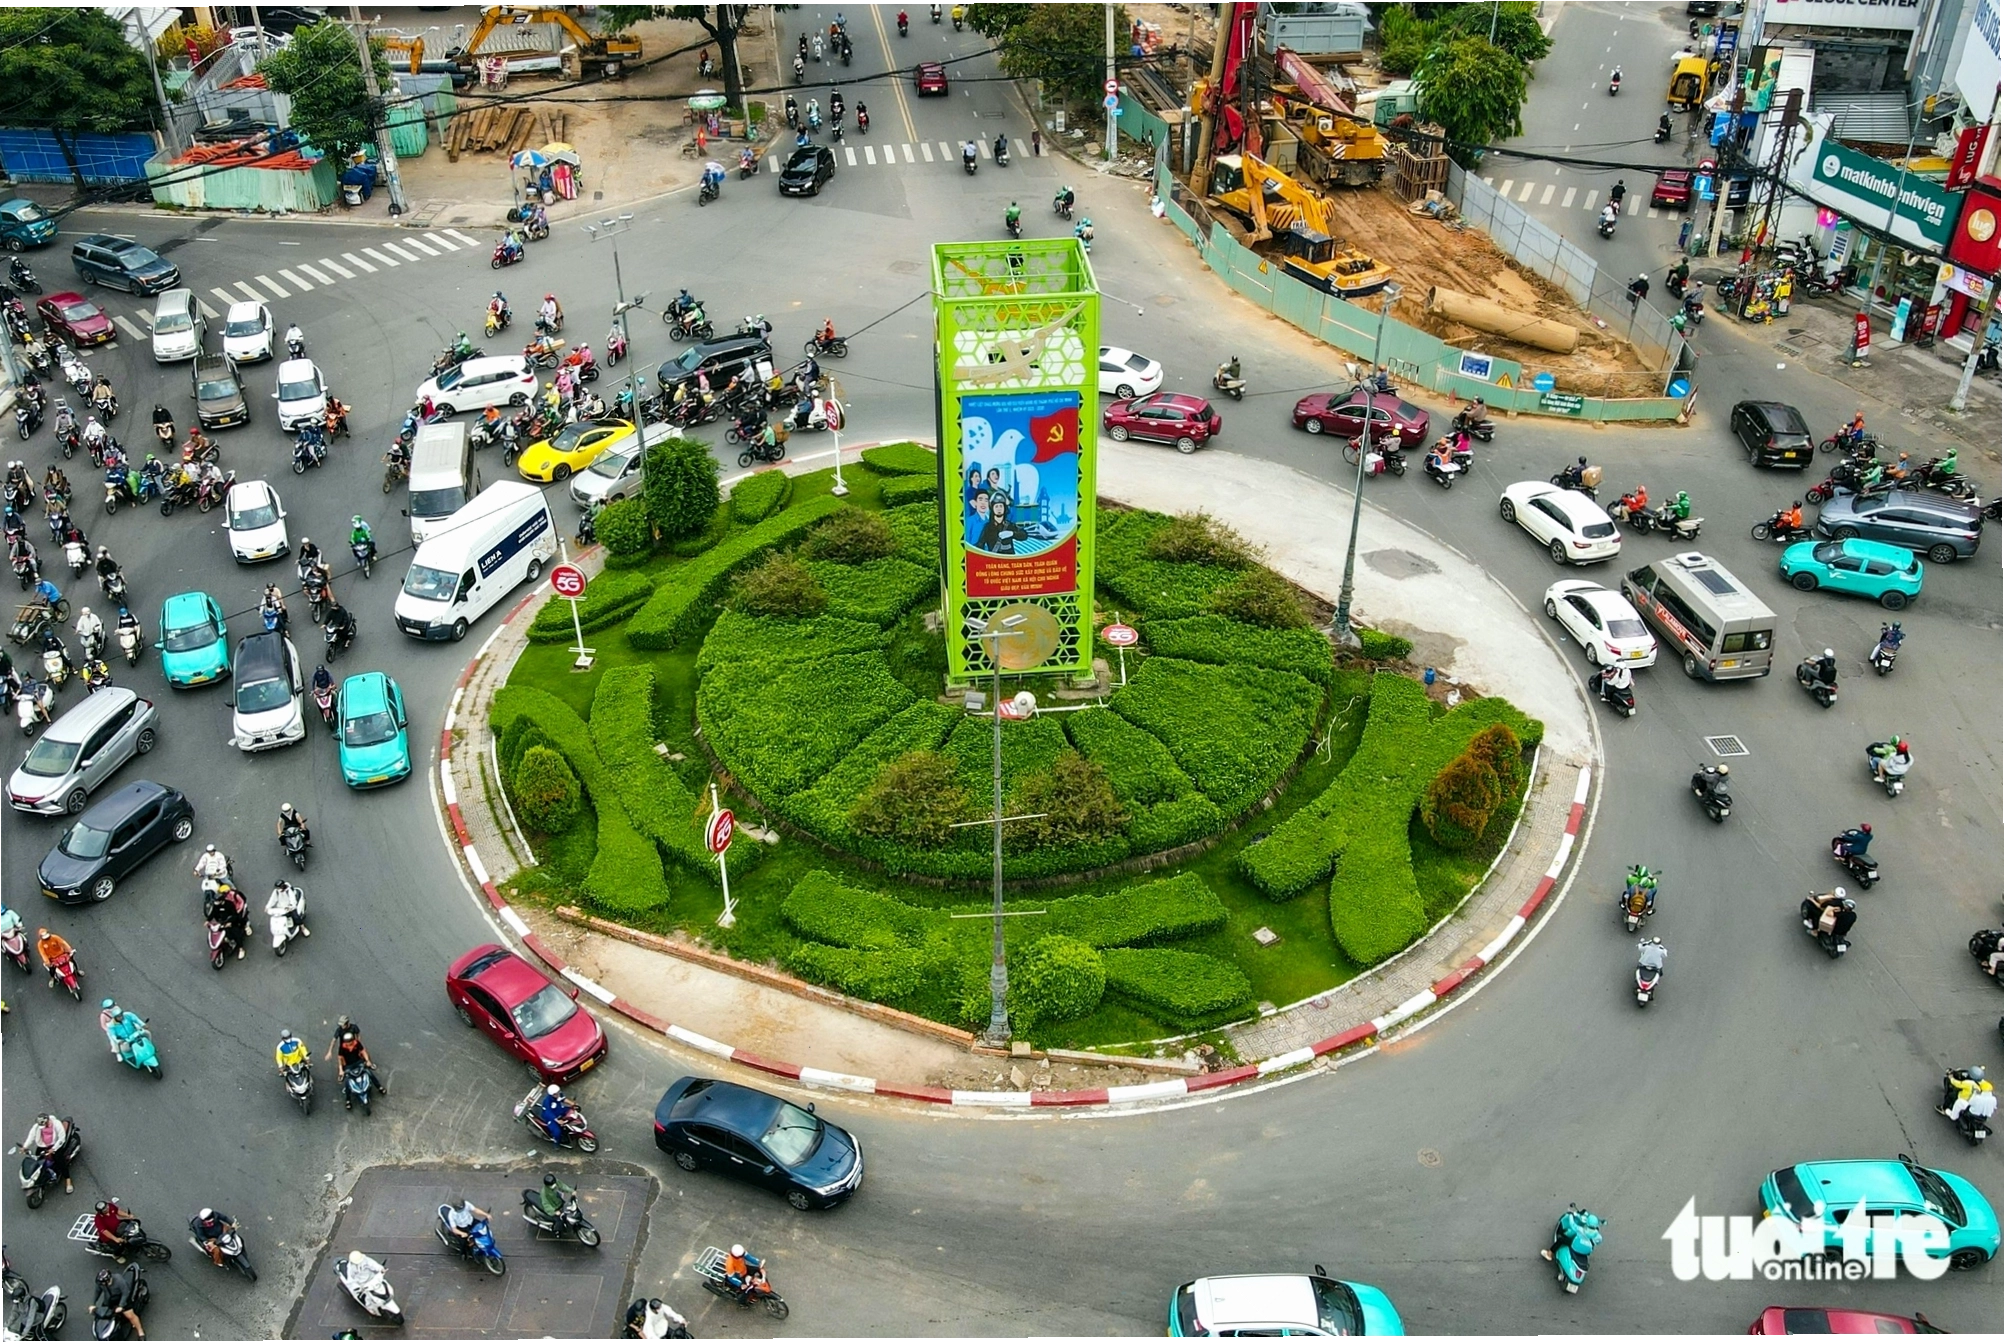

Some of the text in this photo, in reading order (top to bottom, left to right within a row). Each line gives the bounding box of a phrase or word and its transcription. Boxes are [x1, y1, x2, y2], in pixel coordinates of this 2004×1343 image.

[1972, 211, 1993, 239] lug
[556, 576, 580, 592] 5G
[1108, 630, 1133, 641] 5G
